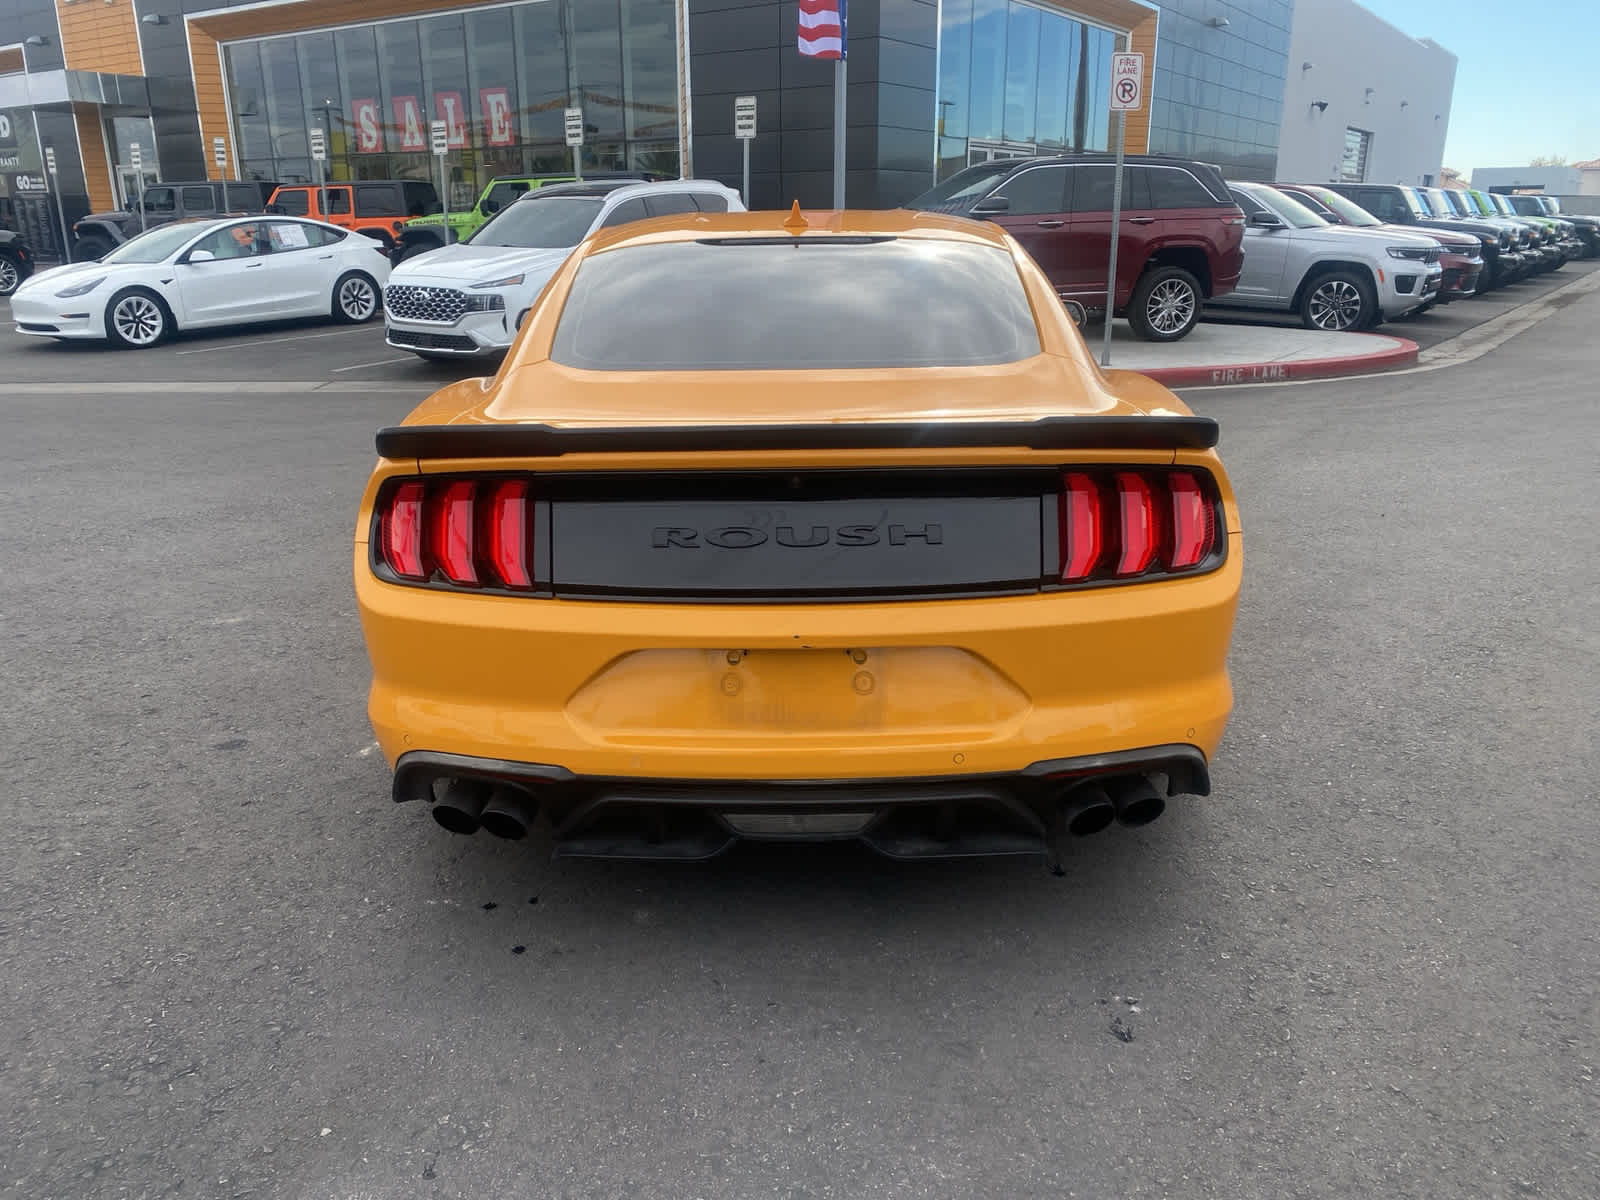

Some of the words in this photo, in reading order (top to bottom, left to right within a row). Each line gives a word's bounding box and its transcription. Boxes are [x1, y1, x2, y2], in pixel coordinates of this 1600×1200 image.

[1117, 66, 1137, 74] LANE
[1119, 58, 1137, 66] FIRE
[359, 94, 510, 149] SALE
[1212, 367, 1243, 385] FIRE
[1251, 365, 1286, 380] LANE
[651, 523, 943, 549] ROUSH
